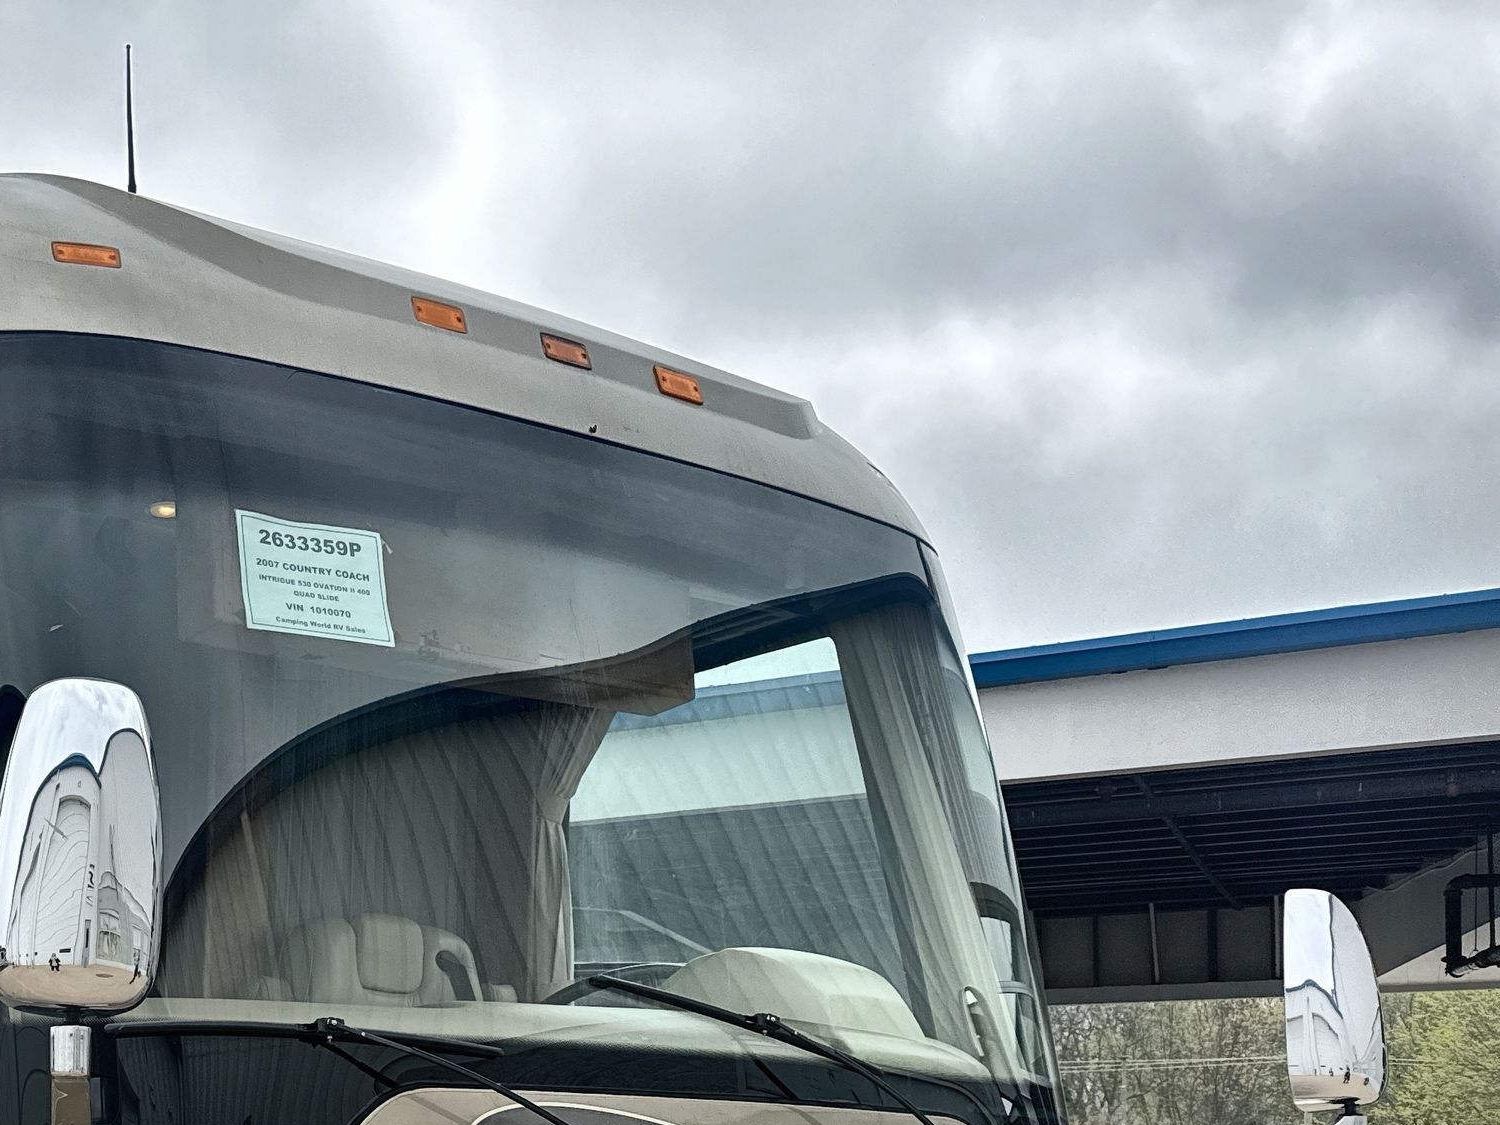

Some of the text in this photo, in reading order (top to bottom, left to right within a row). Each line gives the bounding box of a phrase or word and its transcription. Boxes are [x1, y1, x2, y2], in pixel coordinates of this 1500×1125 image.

[258, 529, 362, 556] 2633359P
[256, 558, 370, 582] 2007 COUNTRY COACH
[259, 574, 295, 585] INTRIGUE
[298, 580, 311, 588] 530
[313, 582, 348, 592] OVATION
[318, 594, 339, 602] SLIDE
[286, 603, 351, 618] VIN 1010070
[276, 616, 308, 627] Camping
[310, 621, 331, 629] World
[346, 625, 366, 633] Sales
